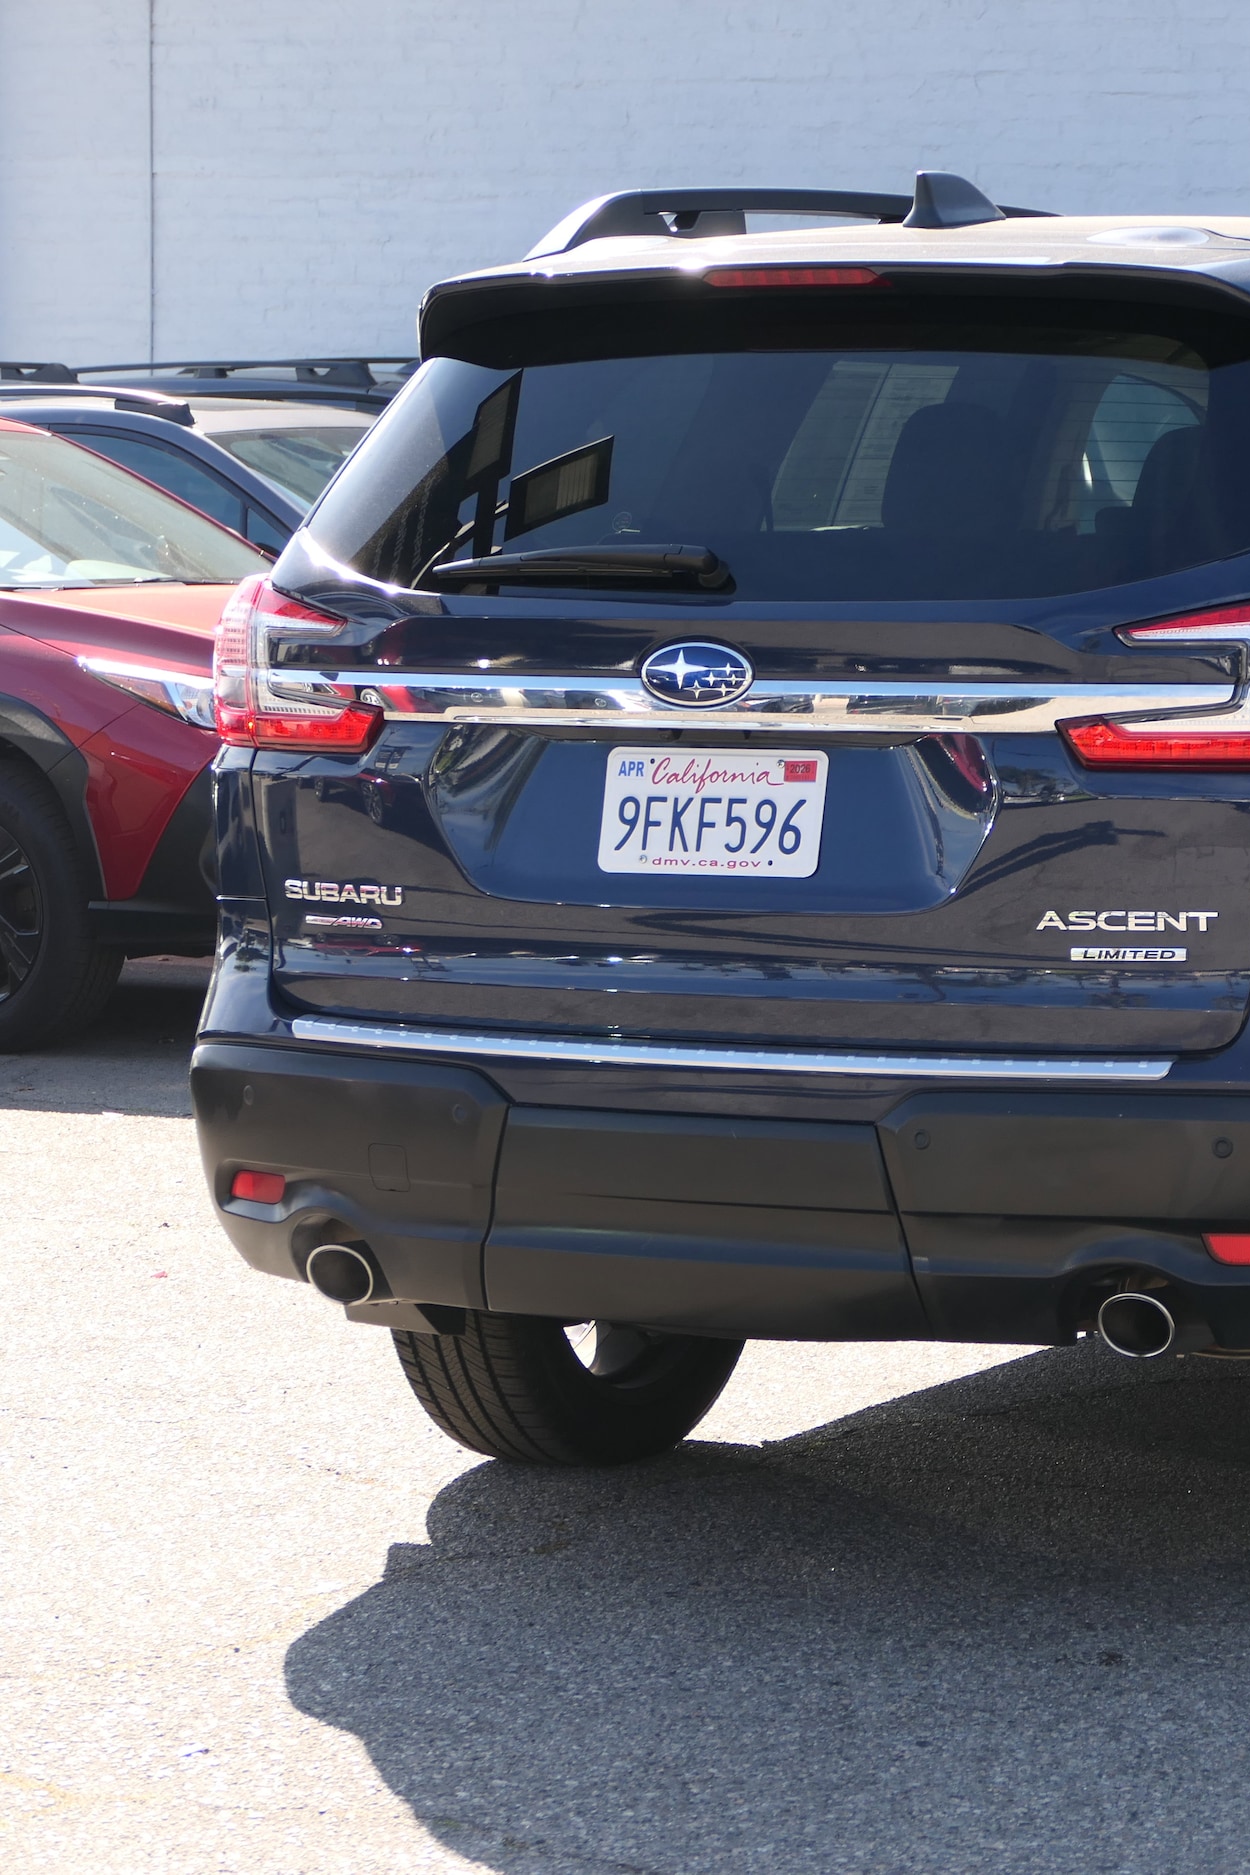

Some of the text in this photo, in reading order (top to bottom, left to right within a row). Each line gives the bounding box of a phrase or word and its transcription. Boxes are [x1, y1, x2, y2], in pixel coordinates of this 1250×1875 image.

[618, 760, 644, 777] APR
[651, 757, 785, 794] California
[790, 764, 811, 774] 2026
[614, 795, 807, 855] 9FKF596
[652, 857, 762, 870] dmv.ca.gov
[284, 879, 402, 906] SUBARU
[333, 916, 383, 930] AWD
[1035, 911, 1219, 932] ASCENT
[1083, 949, 1176, 960] LIMITED
